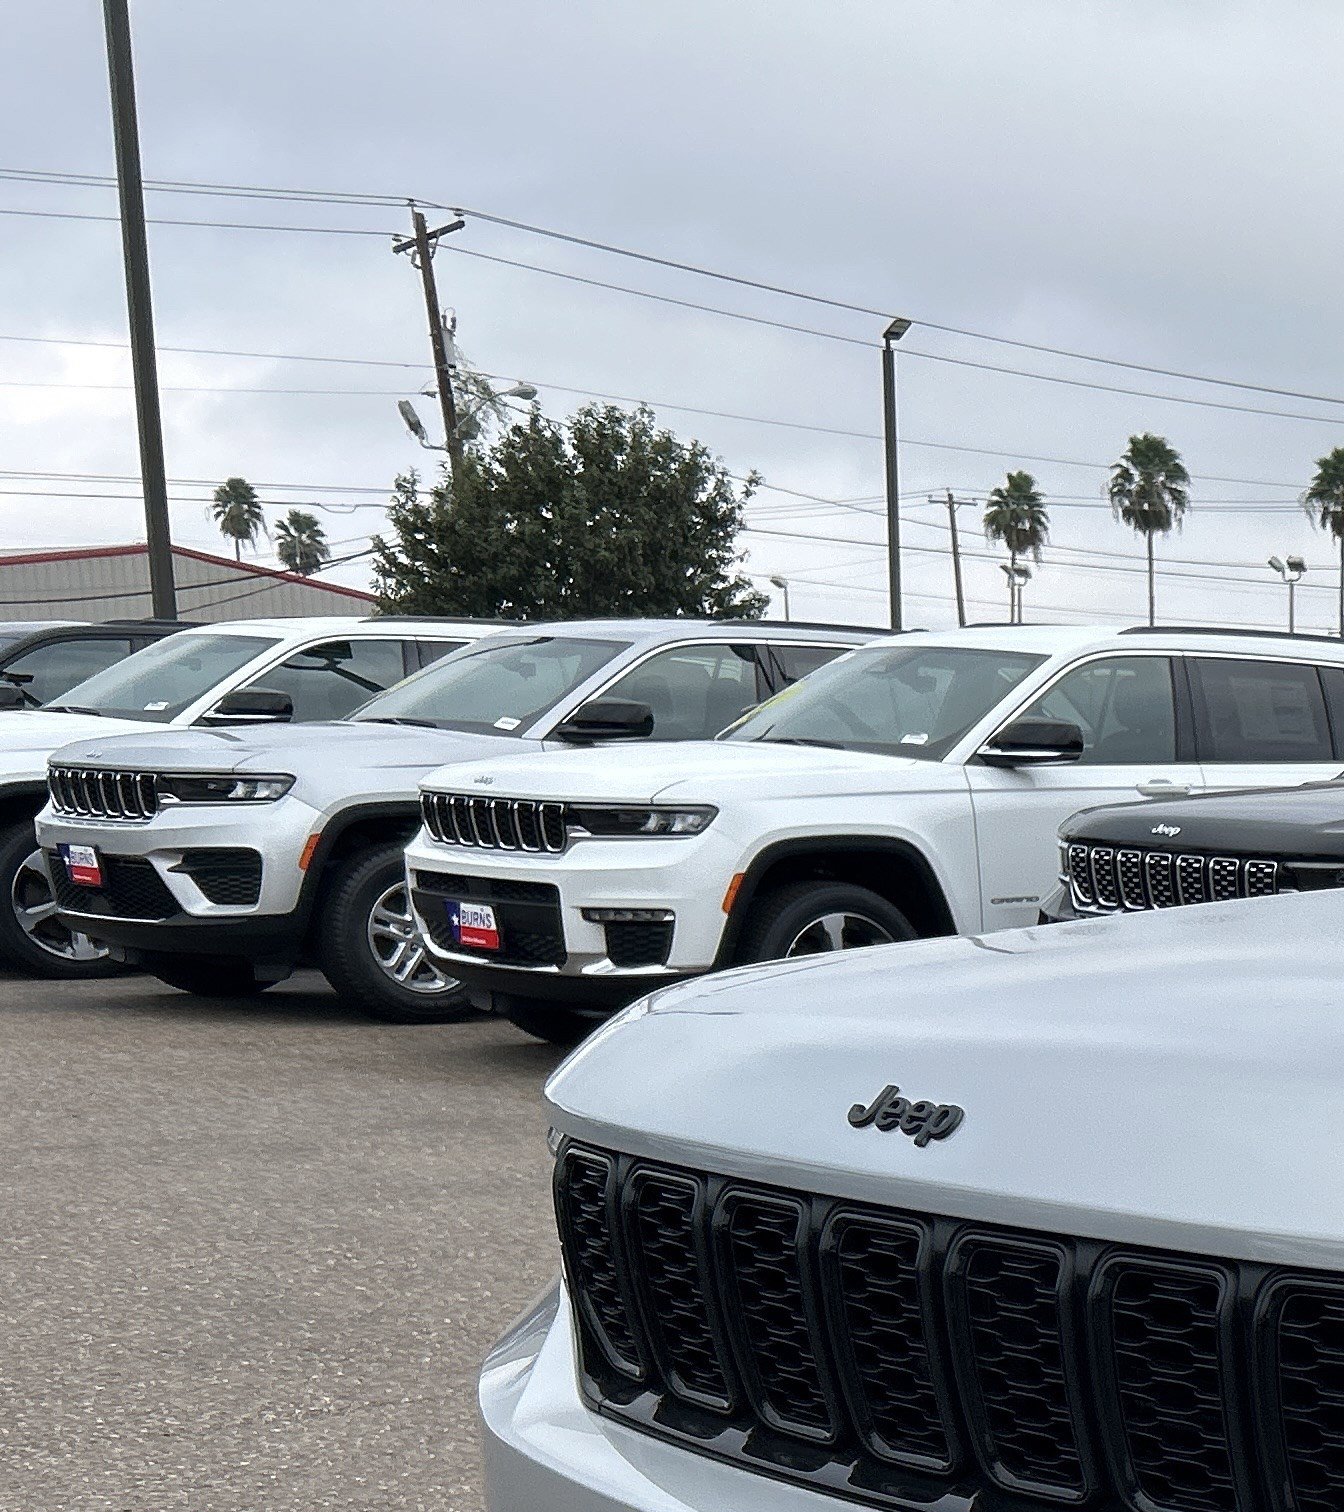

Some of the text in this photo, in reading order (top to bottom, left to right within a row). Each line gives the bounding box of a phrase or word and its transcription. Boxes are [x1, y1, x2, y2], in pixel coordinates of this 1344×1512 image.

[1151, 823, 1181, 837] Jeep
[461, 909, 492, 929] BURNS
[847, 1084, 965, 1148] Jeep
